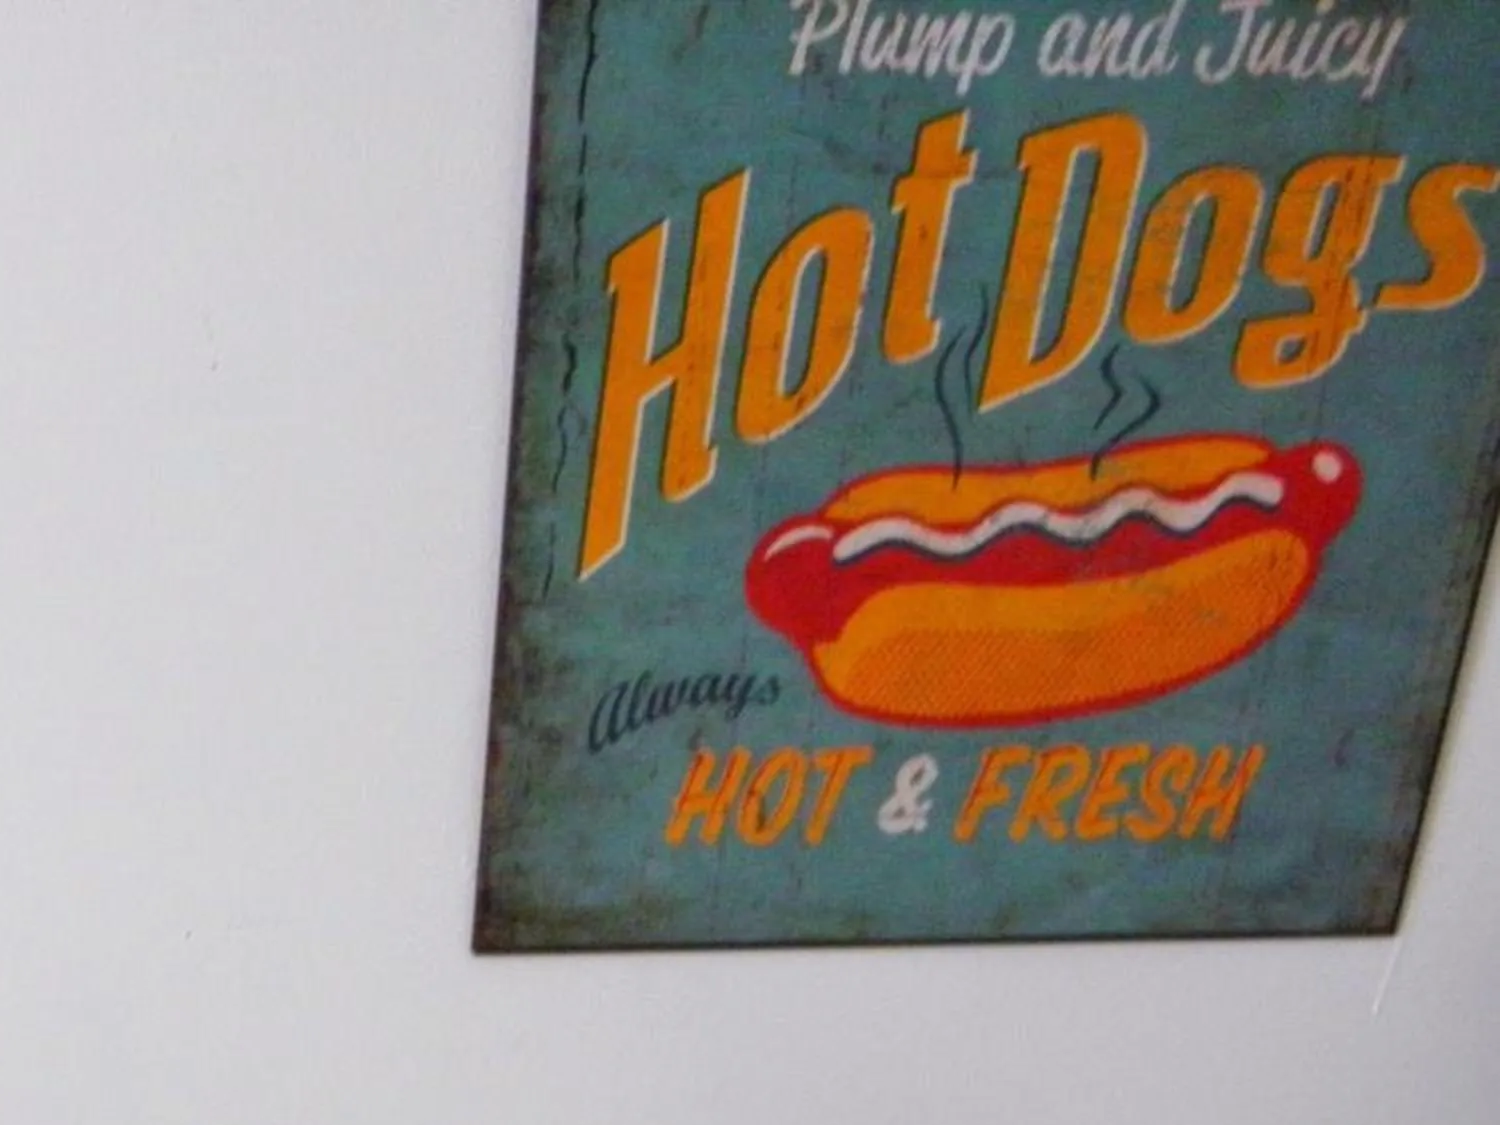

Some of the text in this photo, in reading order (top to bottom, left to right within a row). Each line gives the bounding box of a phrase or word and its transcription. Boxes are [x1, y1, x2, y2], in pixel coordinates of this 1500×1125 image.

[788, 0, 1406, 99] Plump and Juicy
[577, 106, 1500, 581] Hot Dogs
[588, 666, 781, 753] Always
[665, 742, 1265, 845] HOT & FRESH
